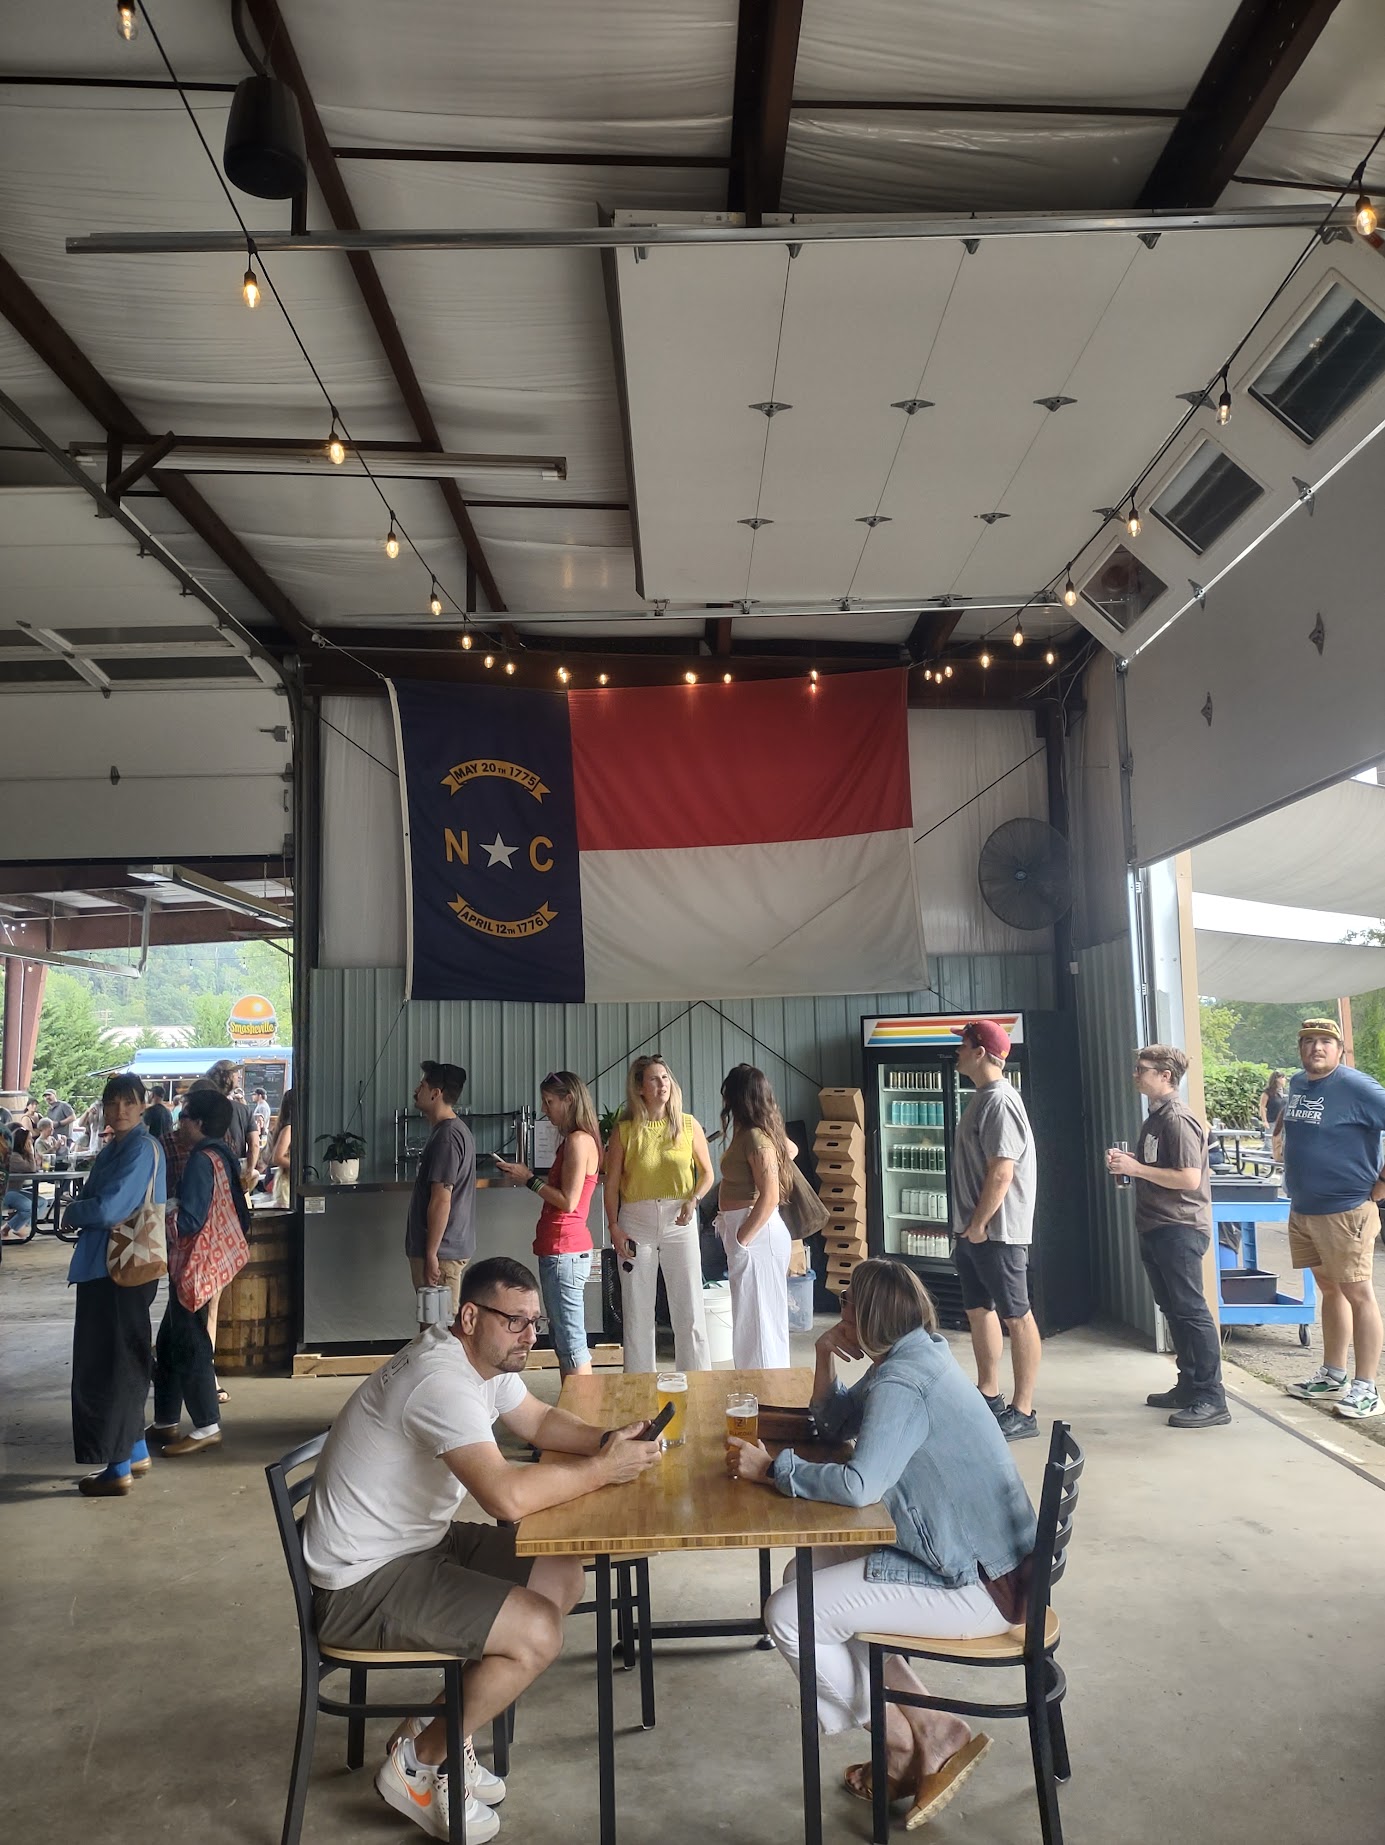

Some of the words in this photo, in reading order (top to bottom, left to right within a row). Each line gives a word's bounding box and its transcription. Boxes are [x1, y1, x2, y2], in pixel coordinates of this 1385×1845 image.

[453, 763, 478, 780] MAY
[509, 767, 537, 786] 1775
[444, 827, 469, 865] N
[529, 835, 555, 873] C
[460, 911, 493, 932] APRIL
[516, 916, 544, 934] 1776
[230, 1021, 275, 1035] Smasheville
